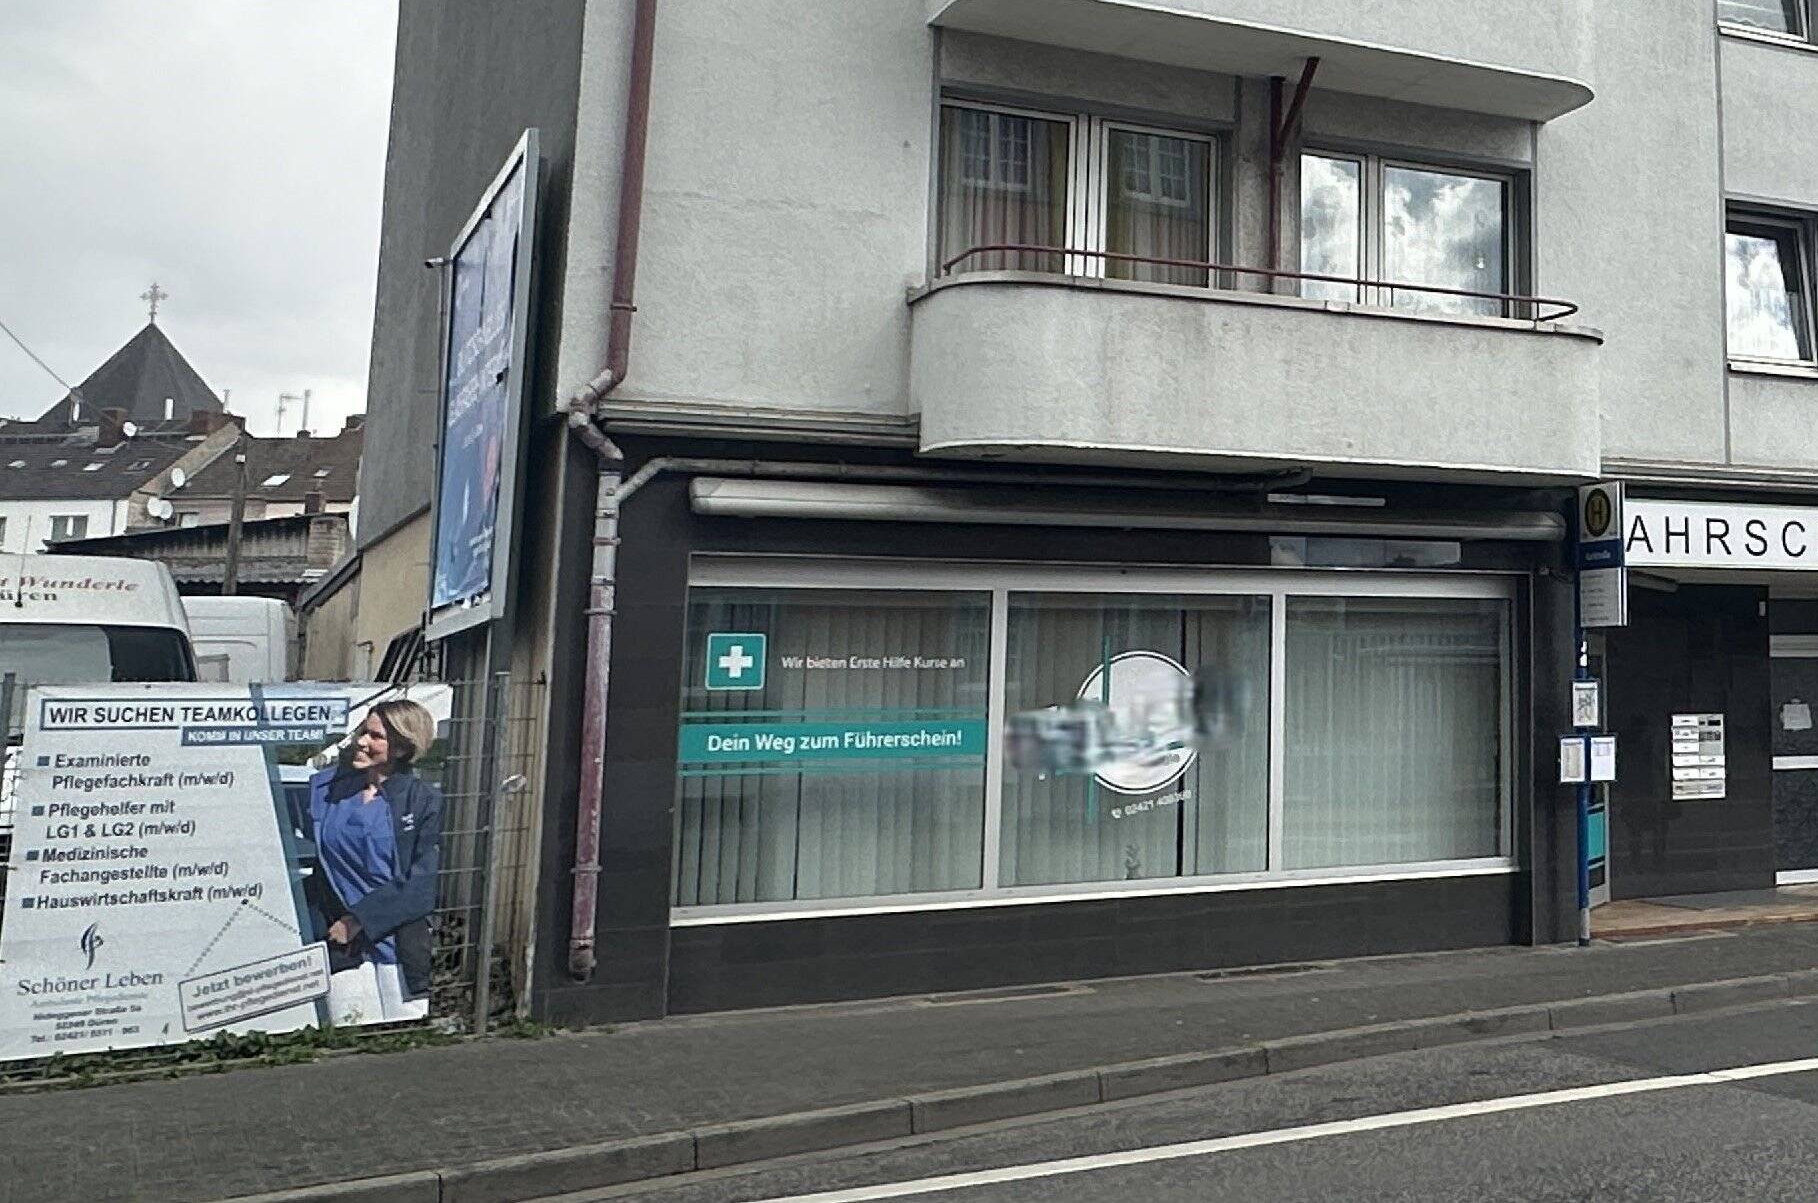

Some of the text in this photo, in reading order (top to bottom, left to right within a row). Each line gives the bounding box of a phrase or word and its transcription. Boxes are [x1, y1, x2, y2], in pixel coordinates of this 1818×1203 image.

[781, 657, 965, 669] Wir bieten Erste Hilfe Kurse an
[50, 705, 330, 723] WIR SUCHEN TEAMKOLLEGEN
[708, 730, 962, 755] Dein Weg zum Führerschein!
[54, 753, 150, 768] Examinierte
[52, 771, 234, 791] Pflegefachkraft (m/w/d)
[48, 800, 175, 819] Pflegehelfer mit
[46, 820, 196, 839] LG1 & LG2 (m/w/d)
[42, 846, 148, 862] Medizinische
[40, 861, 229, 884] Fachangestellte (m/w/d)
[36, 887, 204, 909] Hauswirtschaftskraft
[17, 971, 163, 995] Schöner Leben
[191, 978, 230, 998] Jetzt
[233, 955, 313, 987] bewerben!
